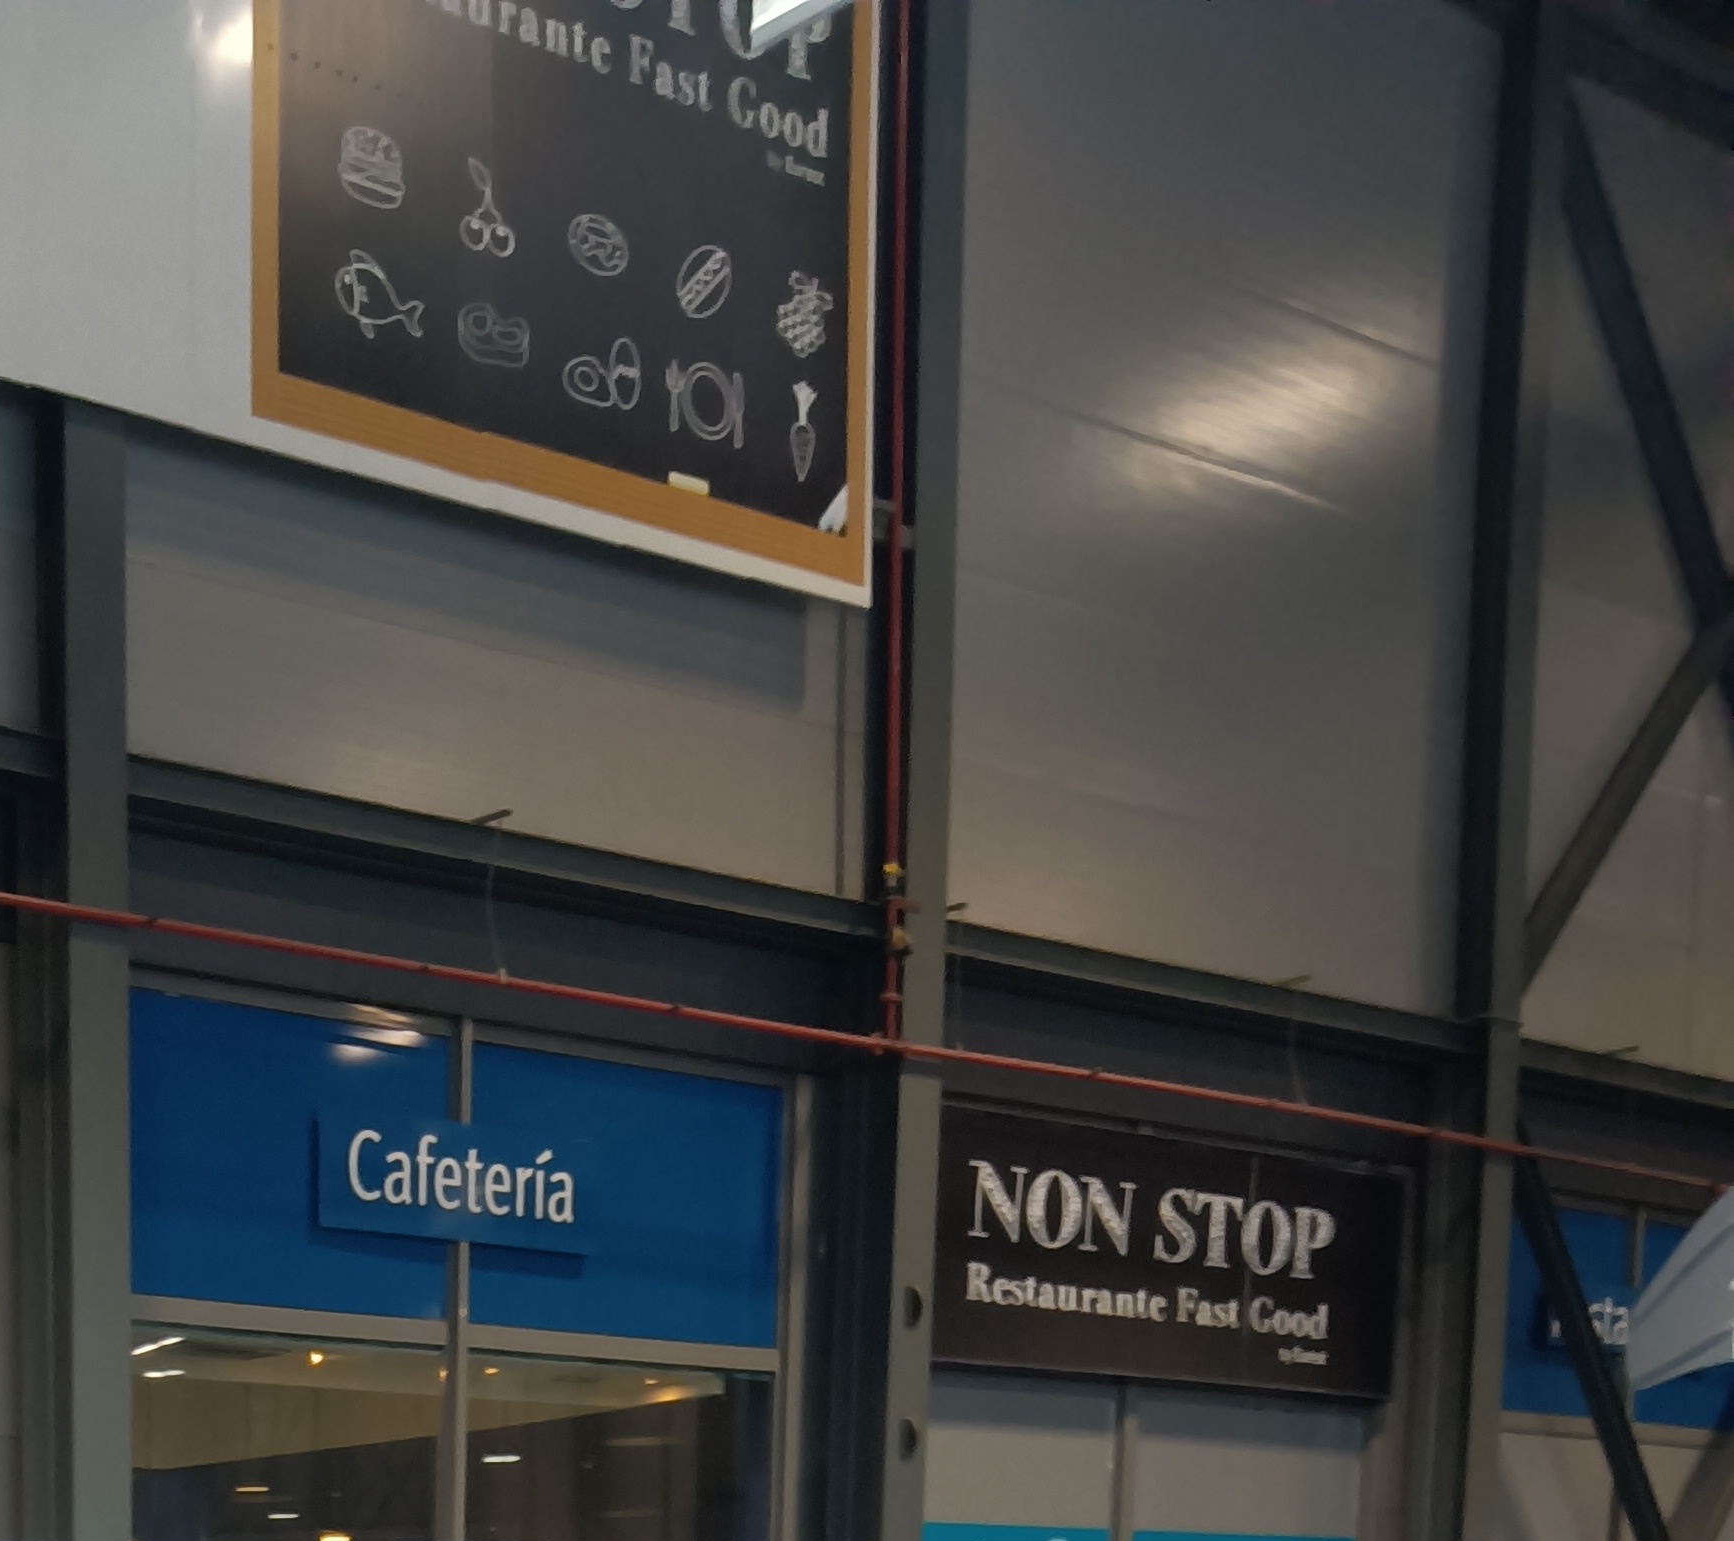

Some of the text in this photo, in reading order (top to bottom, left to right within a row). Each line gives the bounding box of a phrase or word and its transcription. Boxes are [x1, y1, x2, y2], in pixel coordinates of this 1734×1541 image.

[628, 33, 713, 112] Fast
[727, 76, 830, 159] Good
[347, 1128, 576, 1224] Cafetería
[967, 1159, 1337, 1280] NON STOP
[965, 1261, 1329, 1340] Restaurante Fast Good
